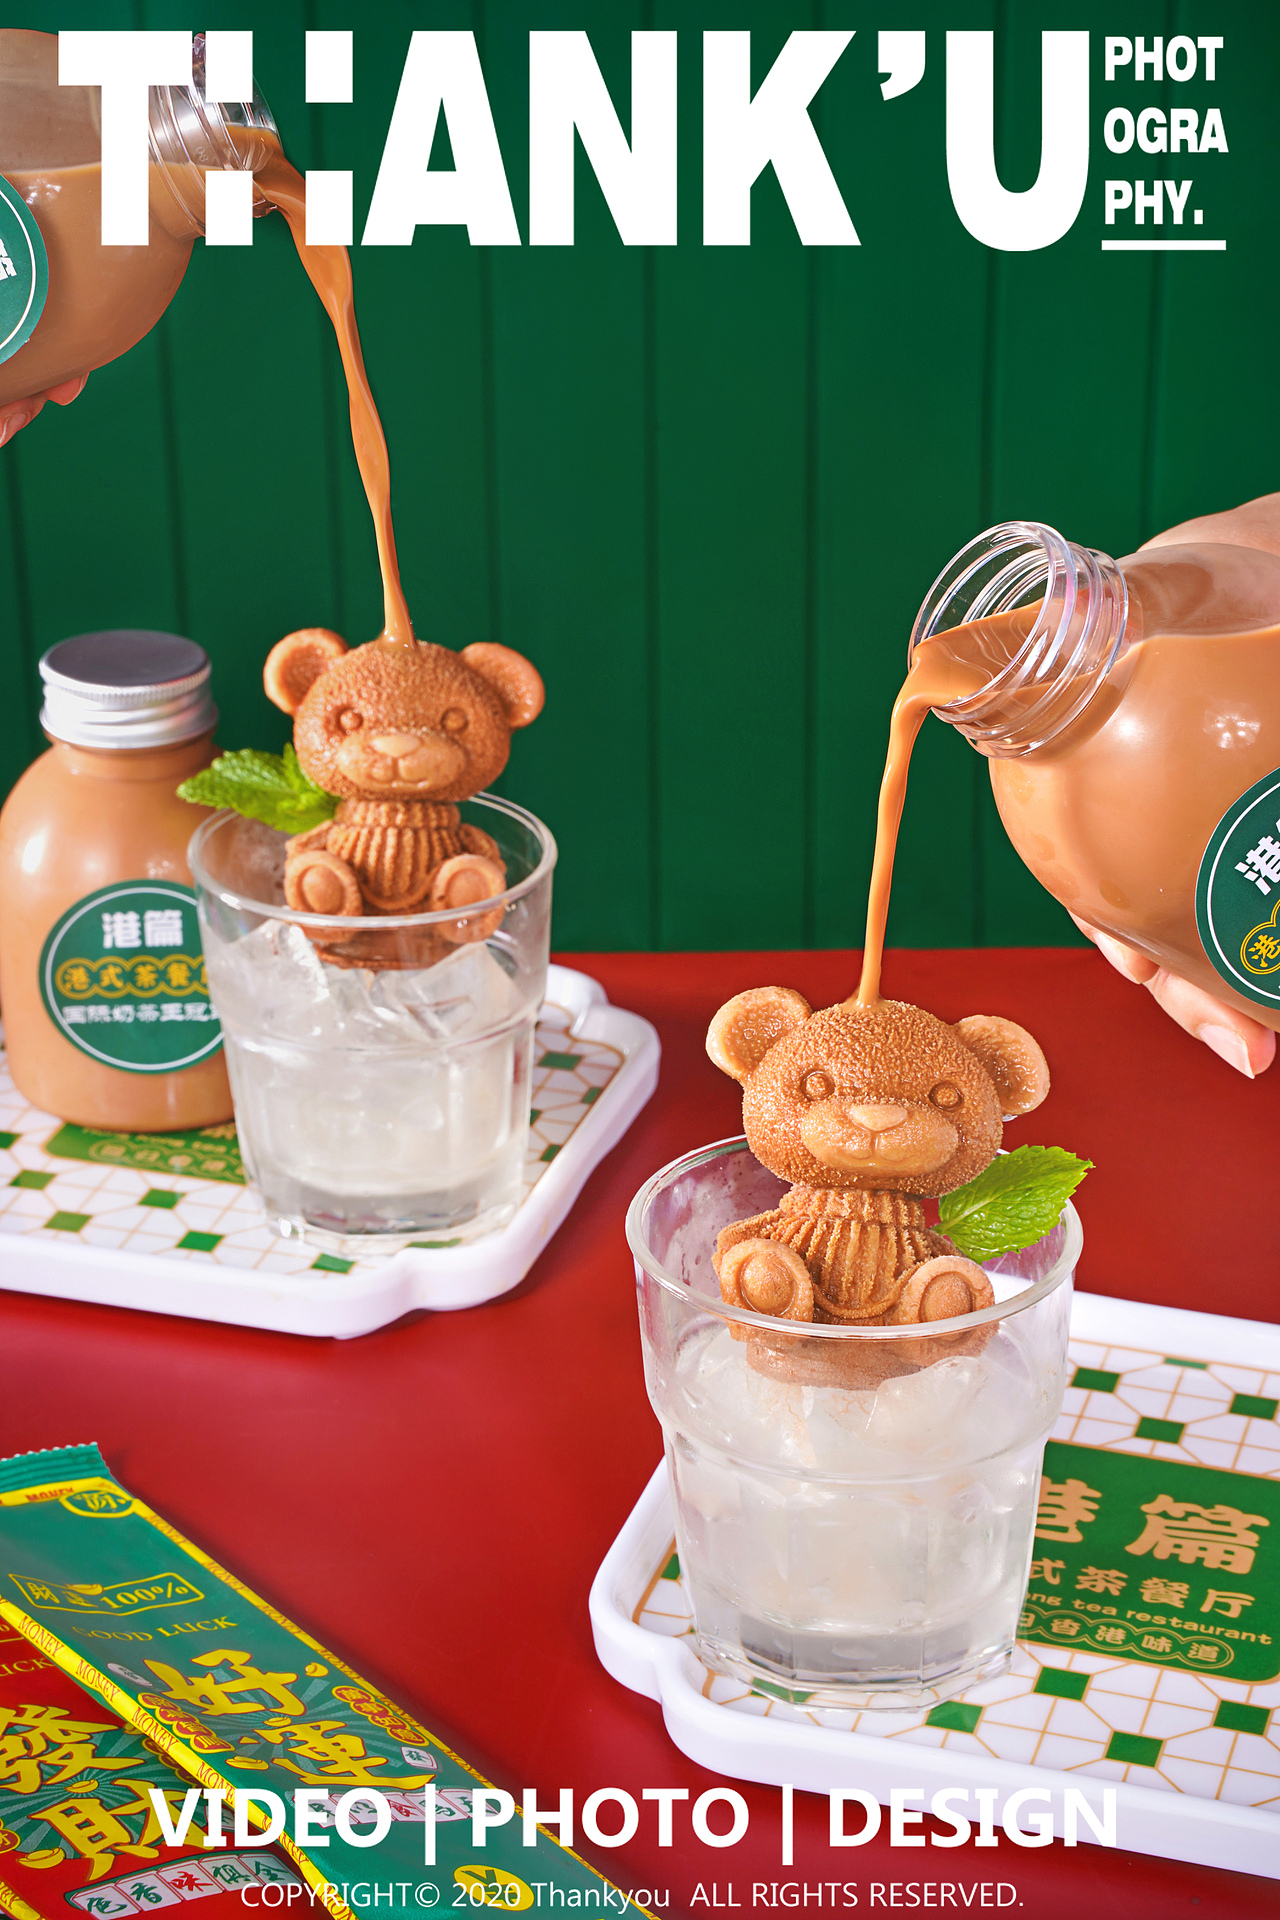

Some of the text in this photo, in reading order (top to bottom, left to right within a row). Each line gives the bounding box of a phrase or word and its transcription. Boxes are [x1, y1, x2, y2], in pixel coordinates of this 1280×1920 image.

[101, 908, 184, 950] 港篇
[18, 1614, 64, 1658] MONEY
[155, 1615, 238, 1638] LUCK
[1071, 1598, 1118, 1616] tea
[1126, 1609, 1273, 1646] restaurant
[76, 1658, 121, 1703] MONEY
[131, 1706, 180, 1753] MONEY
